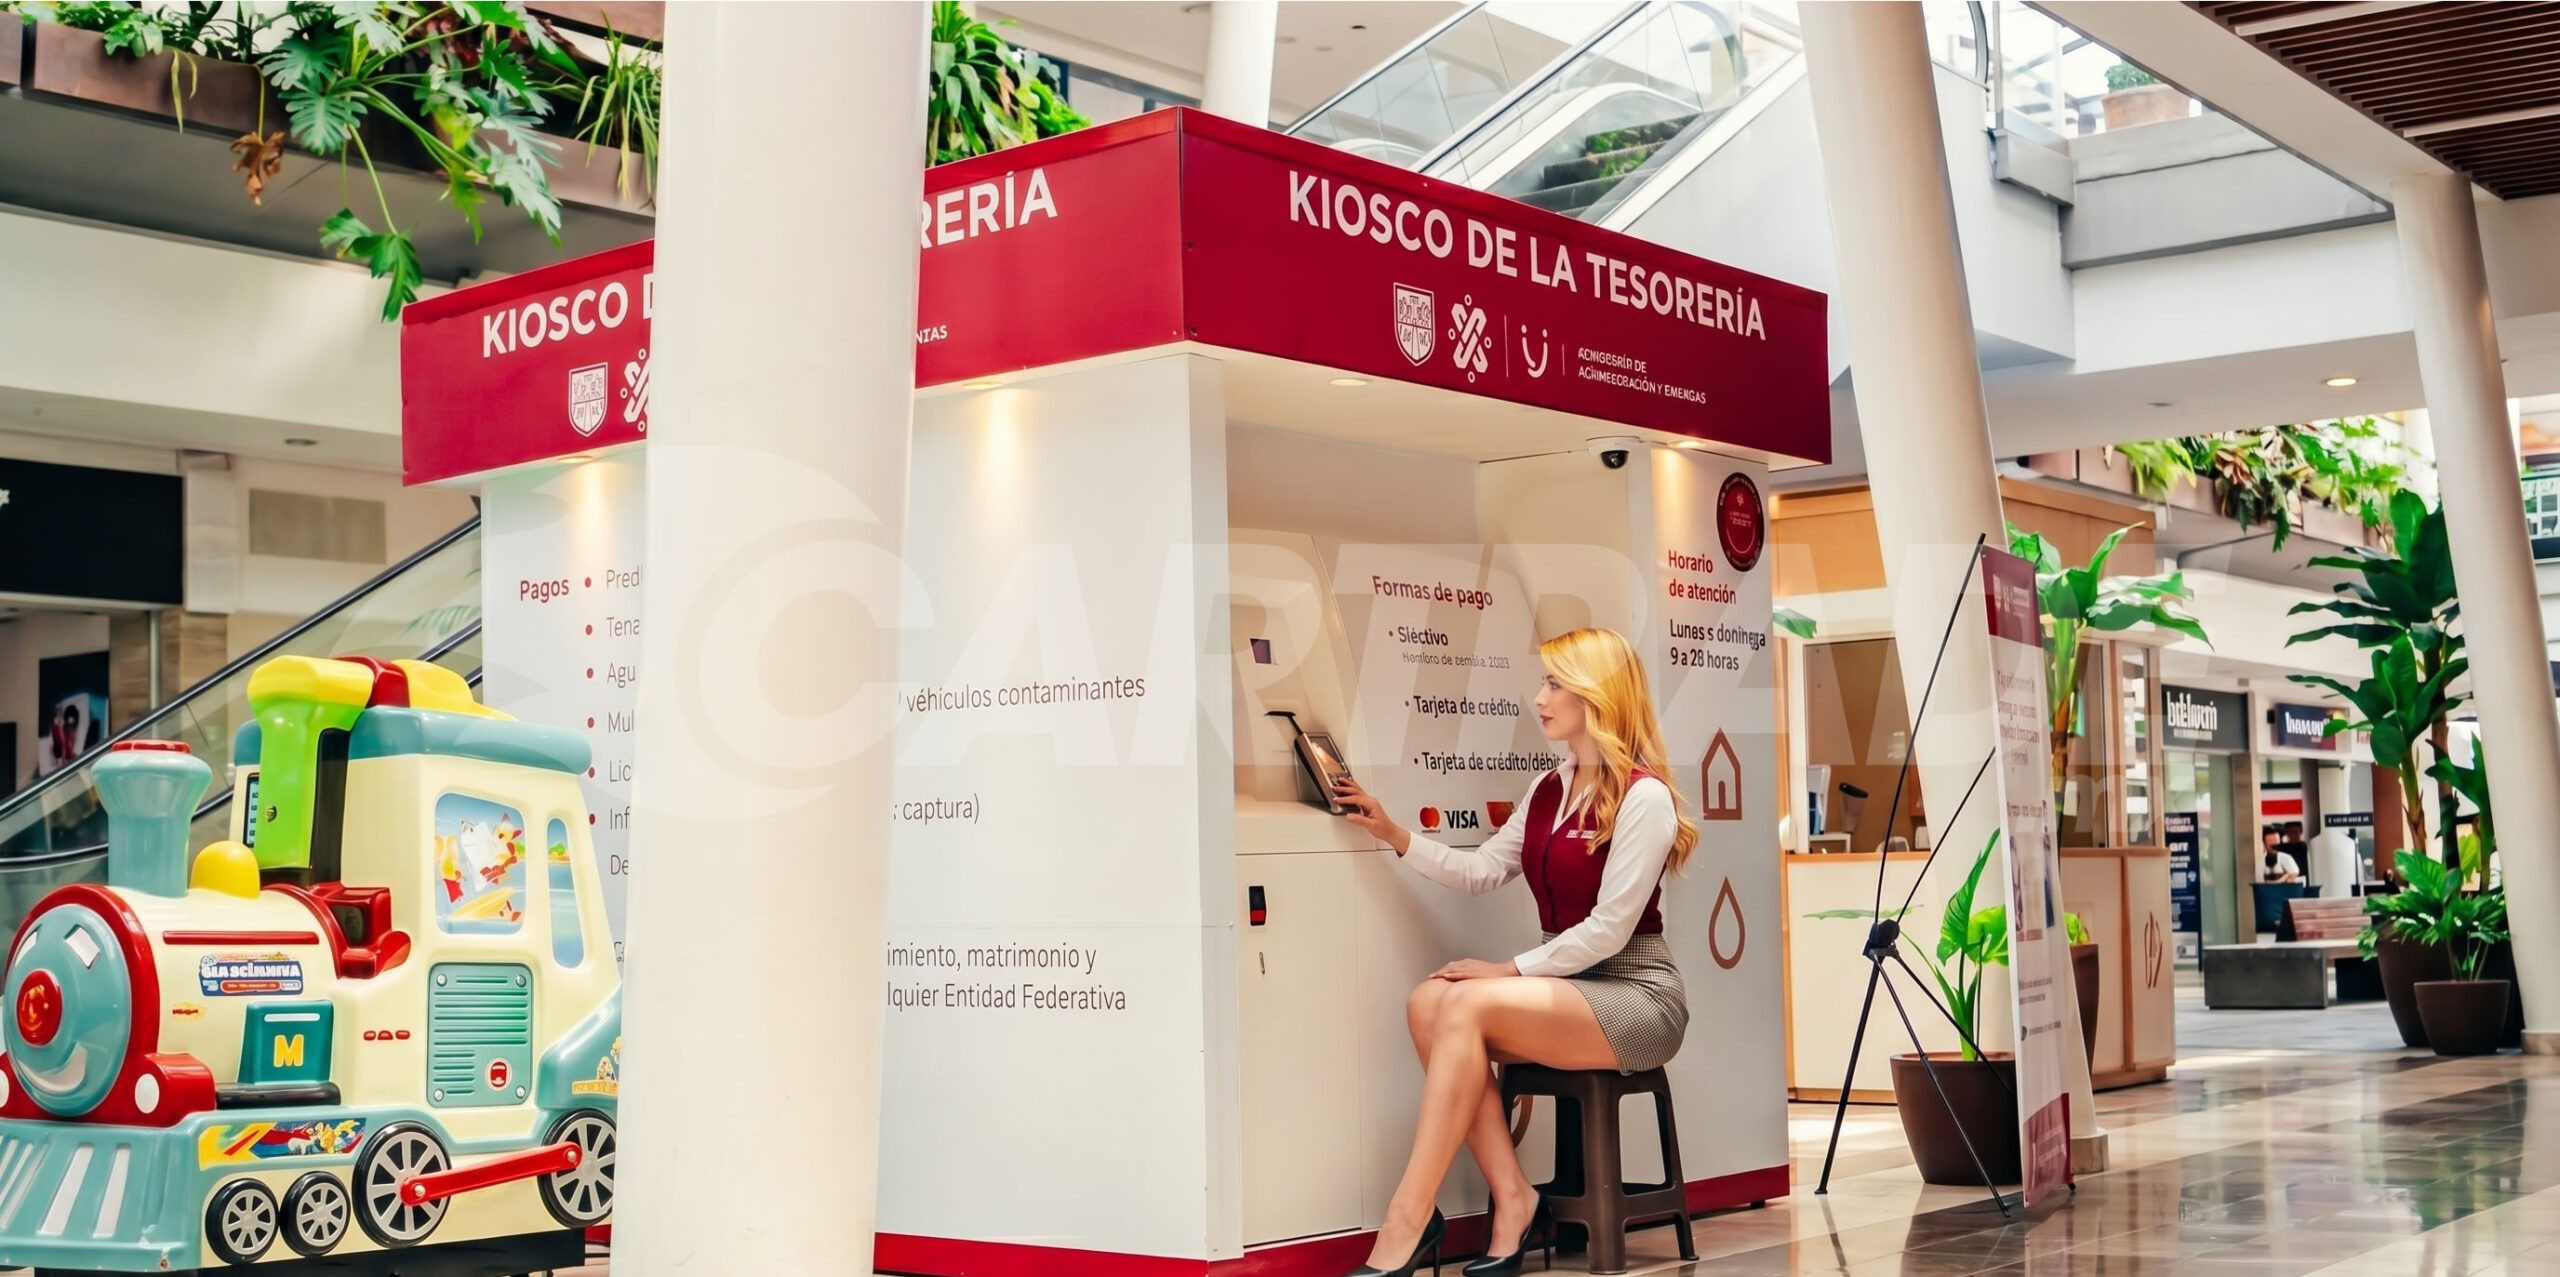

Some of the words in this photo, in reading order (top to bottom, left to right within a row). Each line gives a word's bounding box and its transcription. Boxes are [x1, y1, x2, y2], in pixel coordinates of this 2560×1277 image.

[1289, 169, 1454, 259] KIOSCO
[1467, 218, 1518, 278] DE
[1529, 236, 1578, 293] LA
[1586, 251, 1767, 341] TESORERÍA
[483, 281, 629, 359] KIOSCO
[1668, 549, 1714, 574] Horario
[519, 578, 570, 604] Pagos
[1372, 575, 1431, 601] Formas
[1433, 581, 1453, 603] de
[1456, 586, 1494, 611] pago
[1669, 577, 1685, 597] de
[1687, 583, 1737, 605] atención
[1670, 646, 1679, 666] 9
[1681, 651, 1688, 667] a
[1706, 649, 1740, 671] horas
[606, 661, 636, 689] Agu
[997, 676, 1146, 707] contaminantes
[1412, 695, 1458, 718] Tarjeta
[1460, 697, 1476, 715] de
[1478, 696, 1520, 717] crédito
[1421, 751, 1466, 775] Tarjeta
[1468, 752, 1484, 771] de
[1486, 751, 1567, 773] crédito/débit
[902, 792, 981, 826] captura)
[1444, 810, 1480, 829] VISA
[967, 941, 1081, 969] matrimonio
[1084, 947, 1098, 975] y
[945, 983, 1017, 1009] Entidad
[1022, 984, 1127, 1011] Federativa
[273, 1033, 305, 1068] M
